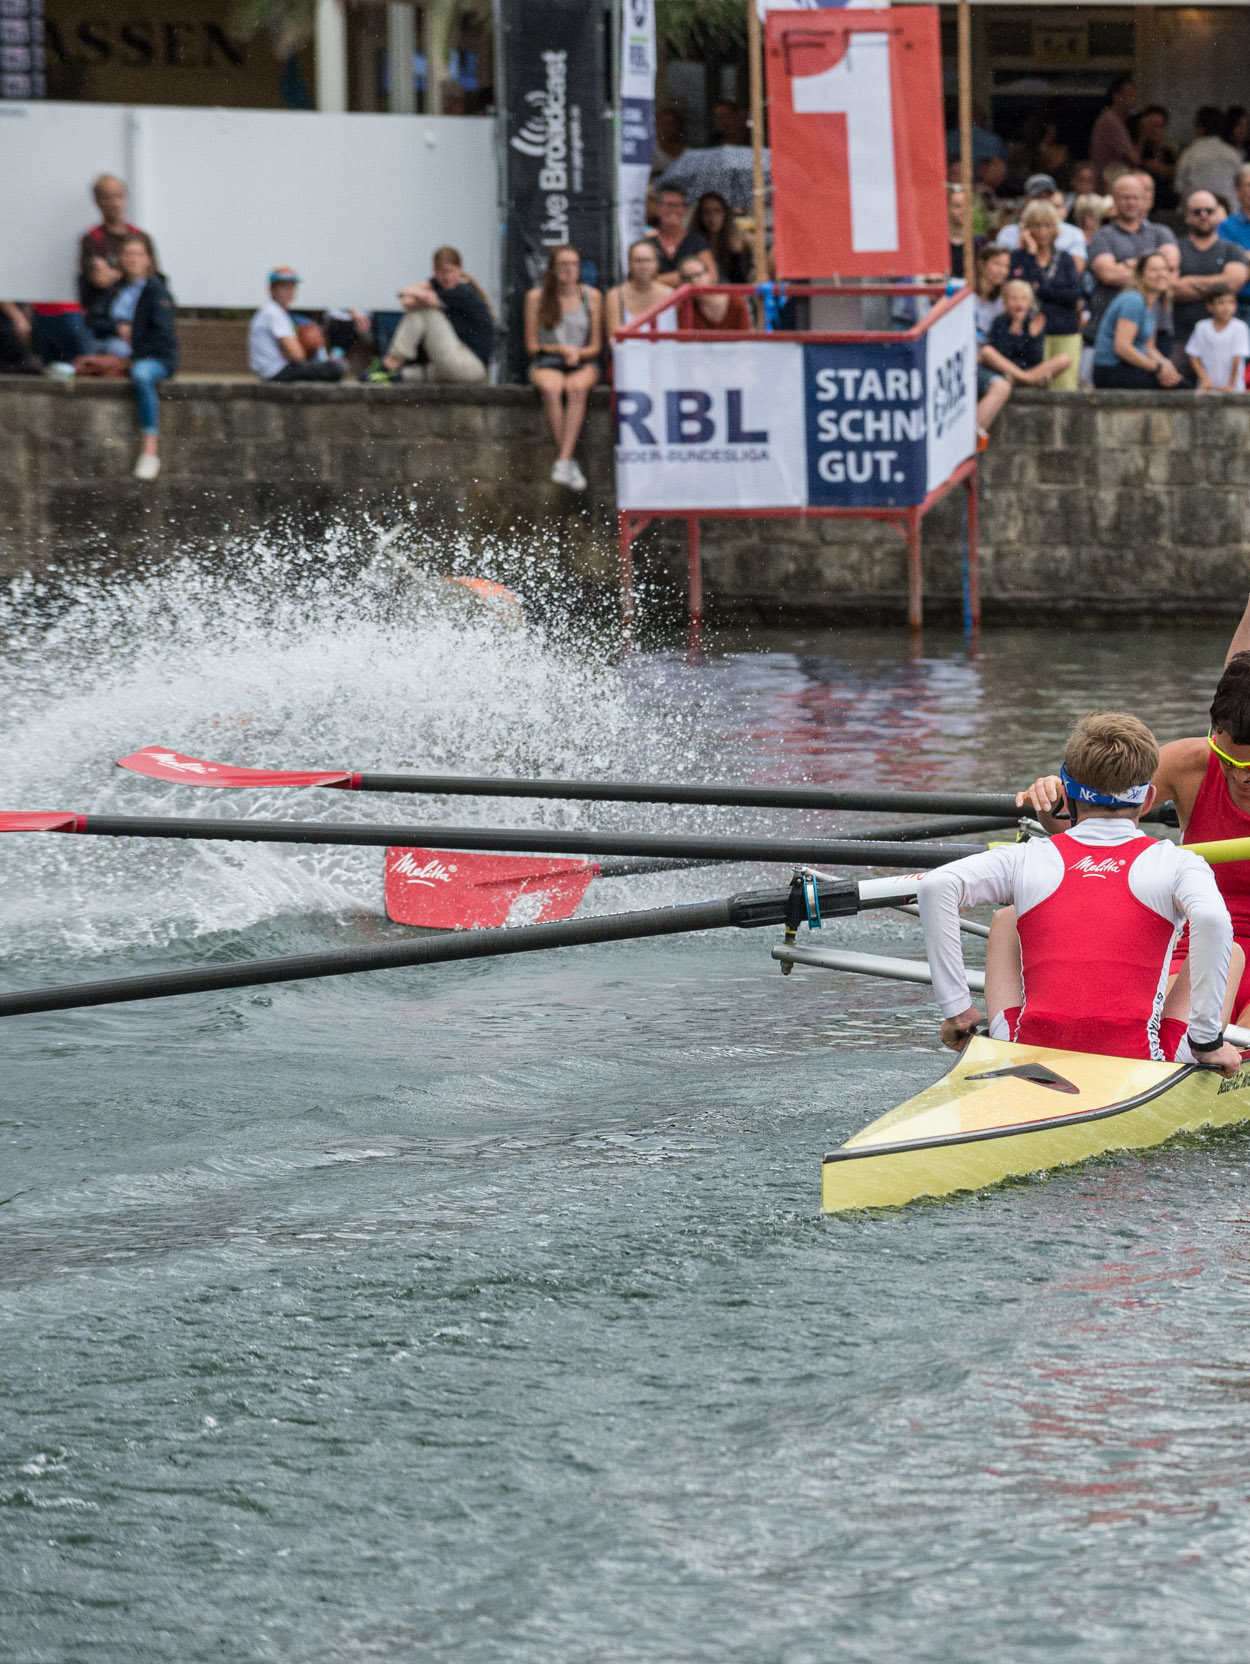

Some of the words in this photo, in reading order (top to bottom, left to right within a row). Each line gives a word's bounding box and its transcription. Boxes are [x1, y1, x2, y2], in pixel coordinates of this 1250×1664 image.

[539, 49, 568, 190] Broadcast
[791, 32, 898, 253] 1
[540, 194, 569, 246] Live
[616, 389, 768, 444] RBL
[818, 450, 905, 483] GUT.
[1080, 787, 1098, 802] NK
[389, 852, 452, 882] Melitta
[1068, 855, 1121, 873] Melitta
